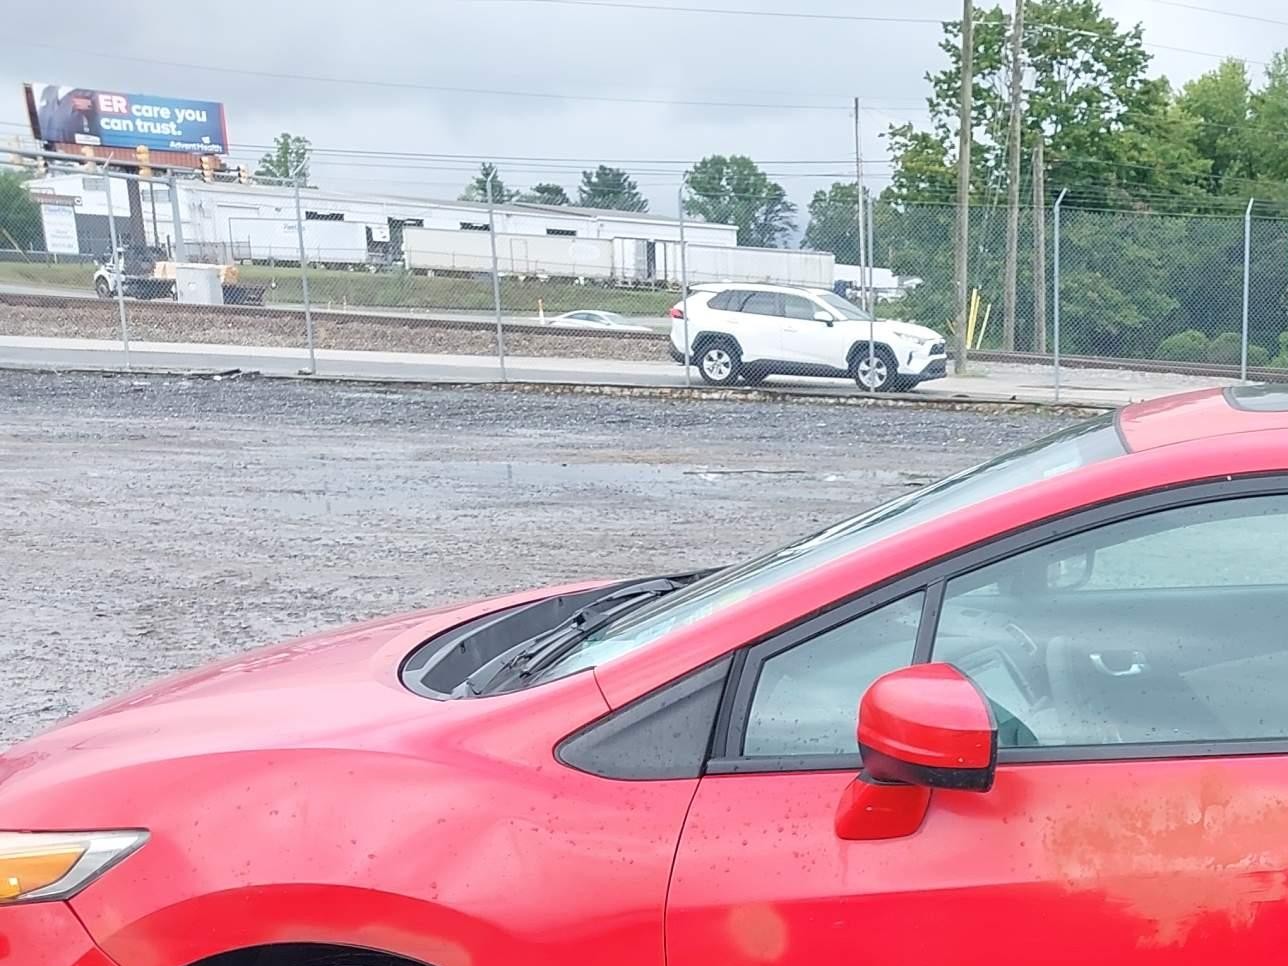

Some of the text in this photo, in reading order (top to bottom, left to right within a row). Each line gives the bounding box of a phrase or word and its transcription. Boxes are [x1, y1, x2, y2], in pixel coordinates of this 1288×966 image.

[98, 94, 207, 123] ER care you
[100, 118, 182, 135] can trust.
